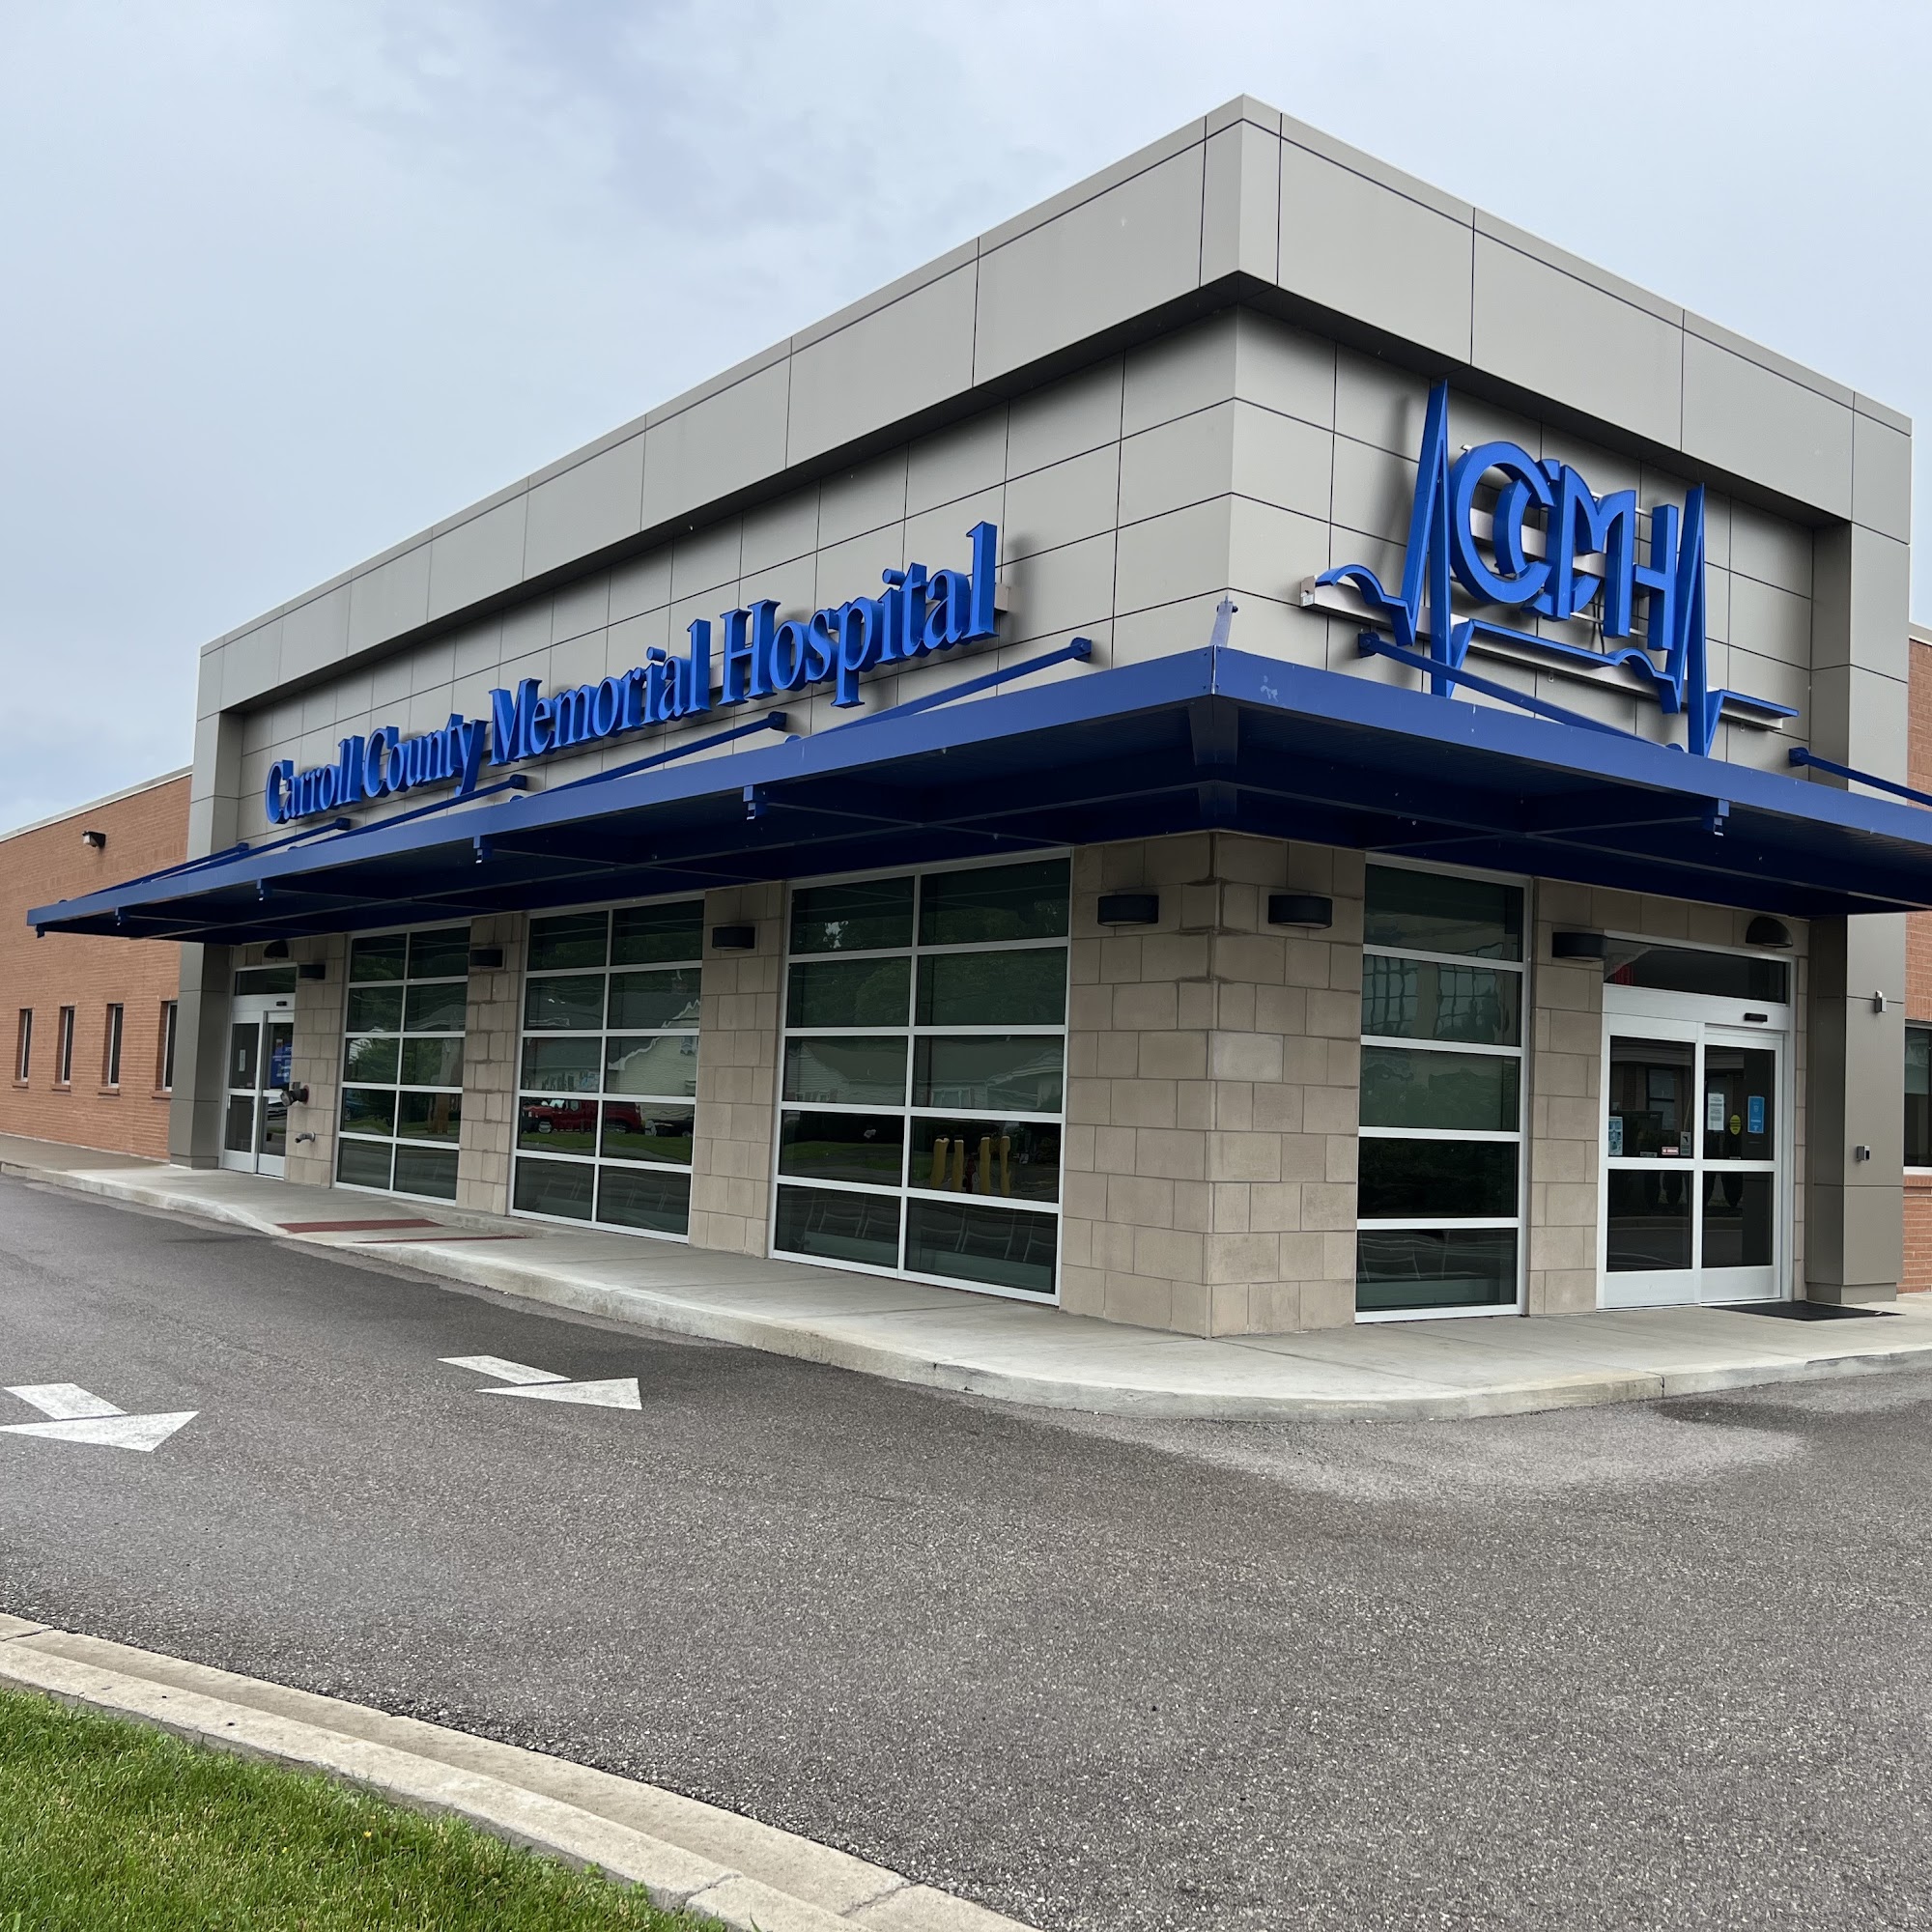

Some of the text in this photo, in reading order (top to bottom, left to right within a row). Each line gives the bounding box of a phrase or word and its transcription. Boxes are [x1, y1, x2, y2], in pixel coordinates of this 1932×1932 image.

[266, 521, 1000, 824] Carroll County Memorial Hospital
[1449, 440, 1679, 652] CCMH
